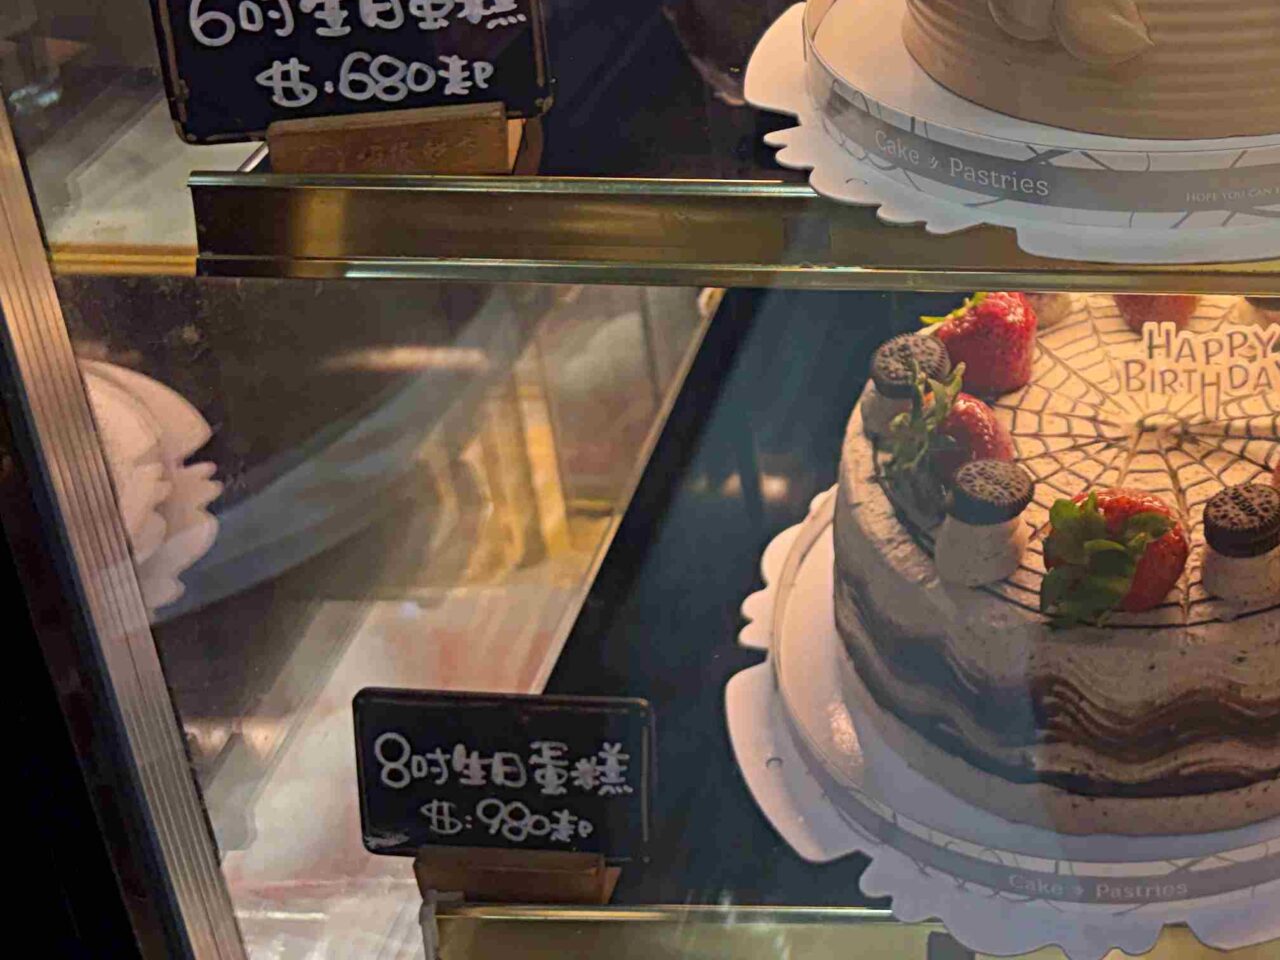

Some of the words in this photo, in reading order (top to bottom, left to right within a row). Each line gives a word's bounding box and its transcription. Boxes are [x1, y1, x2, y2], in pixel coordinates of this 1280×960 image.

[874, 129, 920, 164] Cake
[949, 156, 1050, 196] Pastries
[1147, 328, 1277, 365] HAPPY
[1009, 873, 1063, 897] Cake
[1095, 882, 1189, 901] Pastries
